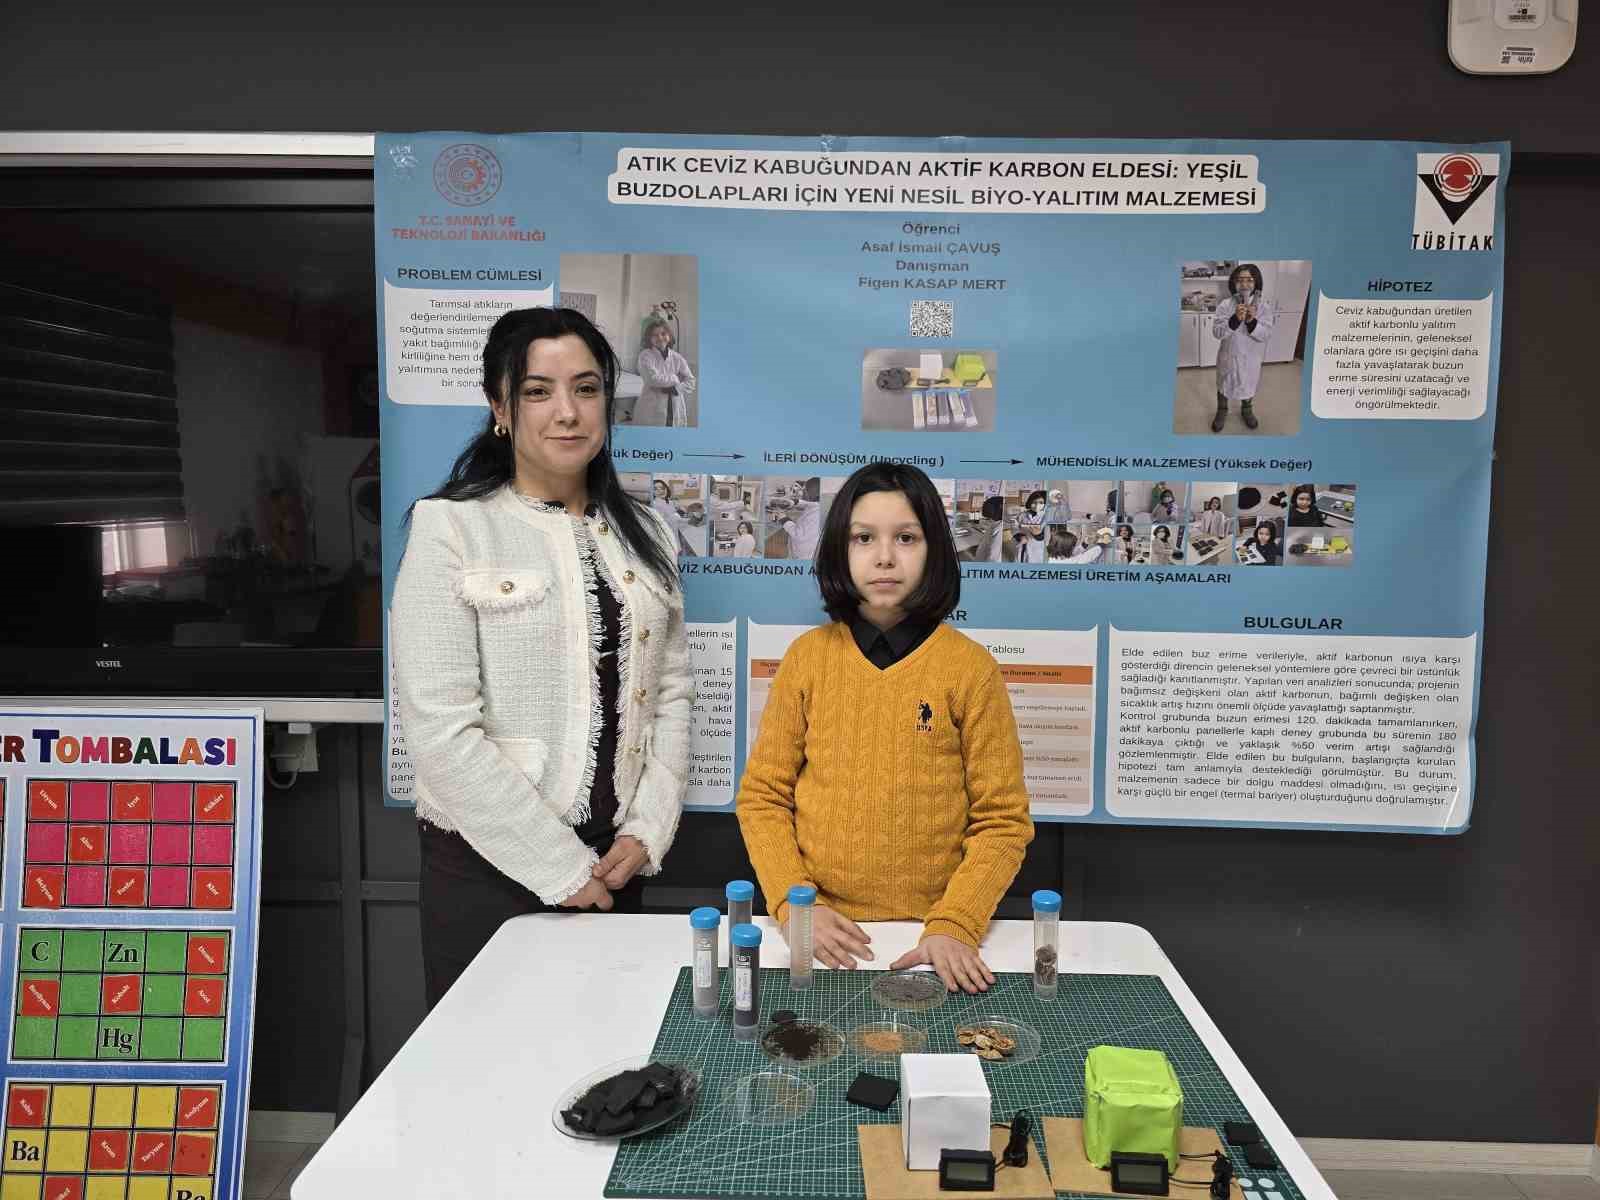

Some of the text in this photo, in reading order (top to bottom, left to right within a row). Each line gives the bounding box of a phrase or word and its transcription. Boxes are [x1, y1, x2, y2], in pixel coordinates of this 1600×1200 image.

[627, 155, 1248, 182] ATIK CEVİZ KABUĞUNDAN AKTİF KARBON ELDESİ: YEŞİL
[617, 182, 1256, 206] BUZDOLAPLARI İÇİN YENİ NESİL BİYO-YALITIM MALZEMESİ
[498, 216, 516, 227] VE
[902, 221, 960, 236] Öğrenci
[1412, 231, 1493, 250] TÜBİTAK
[861, 241, 894, 253] Asaf
[947, 242, 1001, 256] ÇAVUŞ
[896, 260, 969, 273] Danışman
[398, 267, 542, 281] PROBLEM CÜMLESİ
[858, 277, 1006, 290] Figen KASAP MERT
[1367, 279, 1433, 292] HİPOTEZ
[430, 299, 513, 311] Tarımsal atıkların
[1335, 305, 1473, 318] Ceviz kabuğundan üretilen
[400, 326, 444, 335] soğutma
[1349, 320, 1456, 331] aktif karbonlu yalıtım
[402, 339, 428, 348] yakıt
[1331, 333, 1473, 345] malzemelerinin, geleneksel
[448, 353, 470, 361] hem
[1323, 347, 1365, 356] olanlara
[1368, 348, 1392, 358] göre
[1410, 347, 1449, 358] geçişini
[1452, 348, 1479, 357] daha
[1336, 360, 1464, 372] fazla yavaşlatarak buzun
[441, 379, 453, 387] bir
[1328, 374, 1357, 382] erime
[1360, 374, 1401, 383] süresini
[1404, 374, 1454, 385] uzatacağı
[1326, 387, 1355, 398] enerji
[1409, 387, 1471, 399] sağlayacağı
[1355, 400, 1440, 411] öngörülmektedir.
[632, 449, 673, 461] Değer)
[764, 451, 797, 464] İLERİ
[800, 451, 866, 466] DÖNÜŞÜM
[1036, 454, 1313, 472] MÜHENDİSLİK MALZEMESİ (Yüksek Değer)
[677, 561, 698, 574] VİZ
[703, 561, 804, 576] KABUĞUNDAN
[960, 568, 1231, 585] LITIM MALZEMESİ ÜRETİM AŞAMALARI
[1244, 616, 1343, 631] BULGULAR
[987, 644, 1025, 655] Tablosu
[1121, 648, 1144, 657] Elde
[1153, 648, 1183, 657] edilen
[1192, 649, 1210, 658] buz
[1219, 650, 1248, 659] erime
[1316, 653, 1337, 661] aktif
[1345, 653, 1393, 662] karbonun
[1402, 655, 1426, 664] ısıya
[1435, 655, 1461, 665] karşı
[1121, 661, 1461, 677] gösterdiği direncin geleneksel yöntemlere göre çevreci bir üstünlük
[702, 680, 732, 688] deney
[712, 704, 732, 712] aktif
[708, 717, 732, 725] hava
[1120, 712, 1156, 721] Kontrol
[1162, 713, 1210, 723] grubunda
[1216, 714, 1248, 723] buzun
[1253, 714, 1290, 723] erimesi
[1325, 716, 1372, 725] dakikada
[1377, 718, 1458, 728] tamamlanırken,
[700, 729, 732, 737] ölçüde
[1119, 725, 1457, 740] aktif karbonlu panellerle kaplı deney grubunda bu sürenin 180
[32, 729, 236, 765] TOMBALASI
[698, 766, 731, 774] karbon
[707, 778, 731, 787] daha
[1118, 787, 1449, 806] karşı güçlü bir engel (termal bariyer) oluşturduğunu doğrulamıştır.
[31, 941, 49, 961] C
[108, 943, 138, 963] Zn
[103, 1028, 133, 1053] Hg
[10, 1140, 40, 1161] Ba
